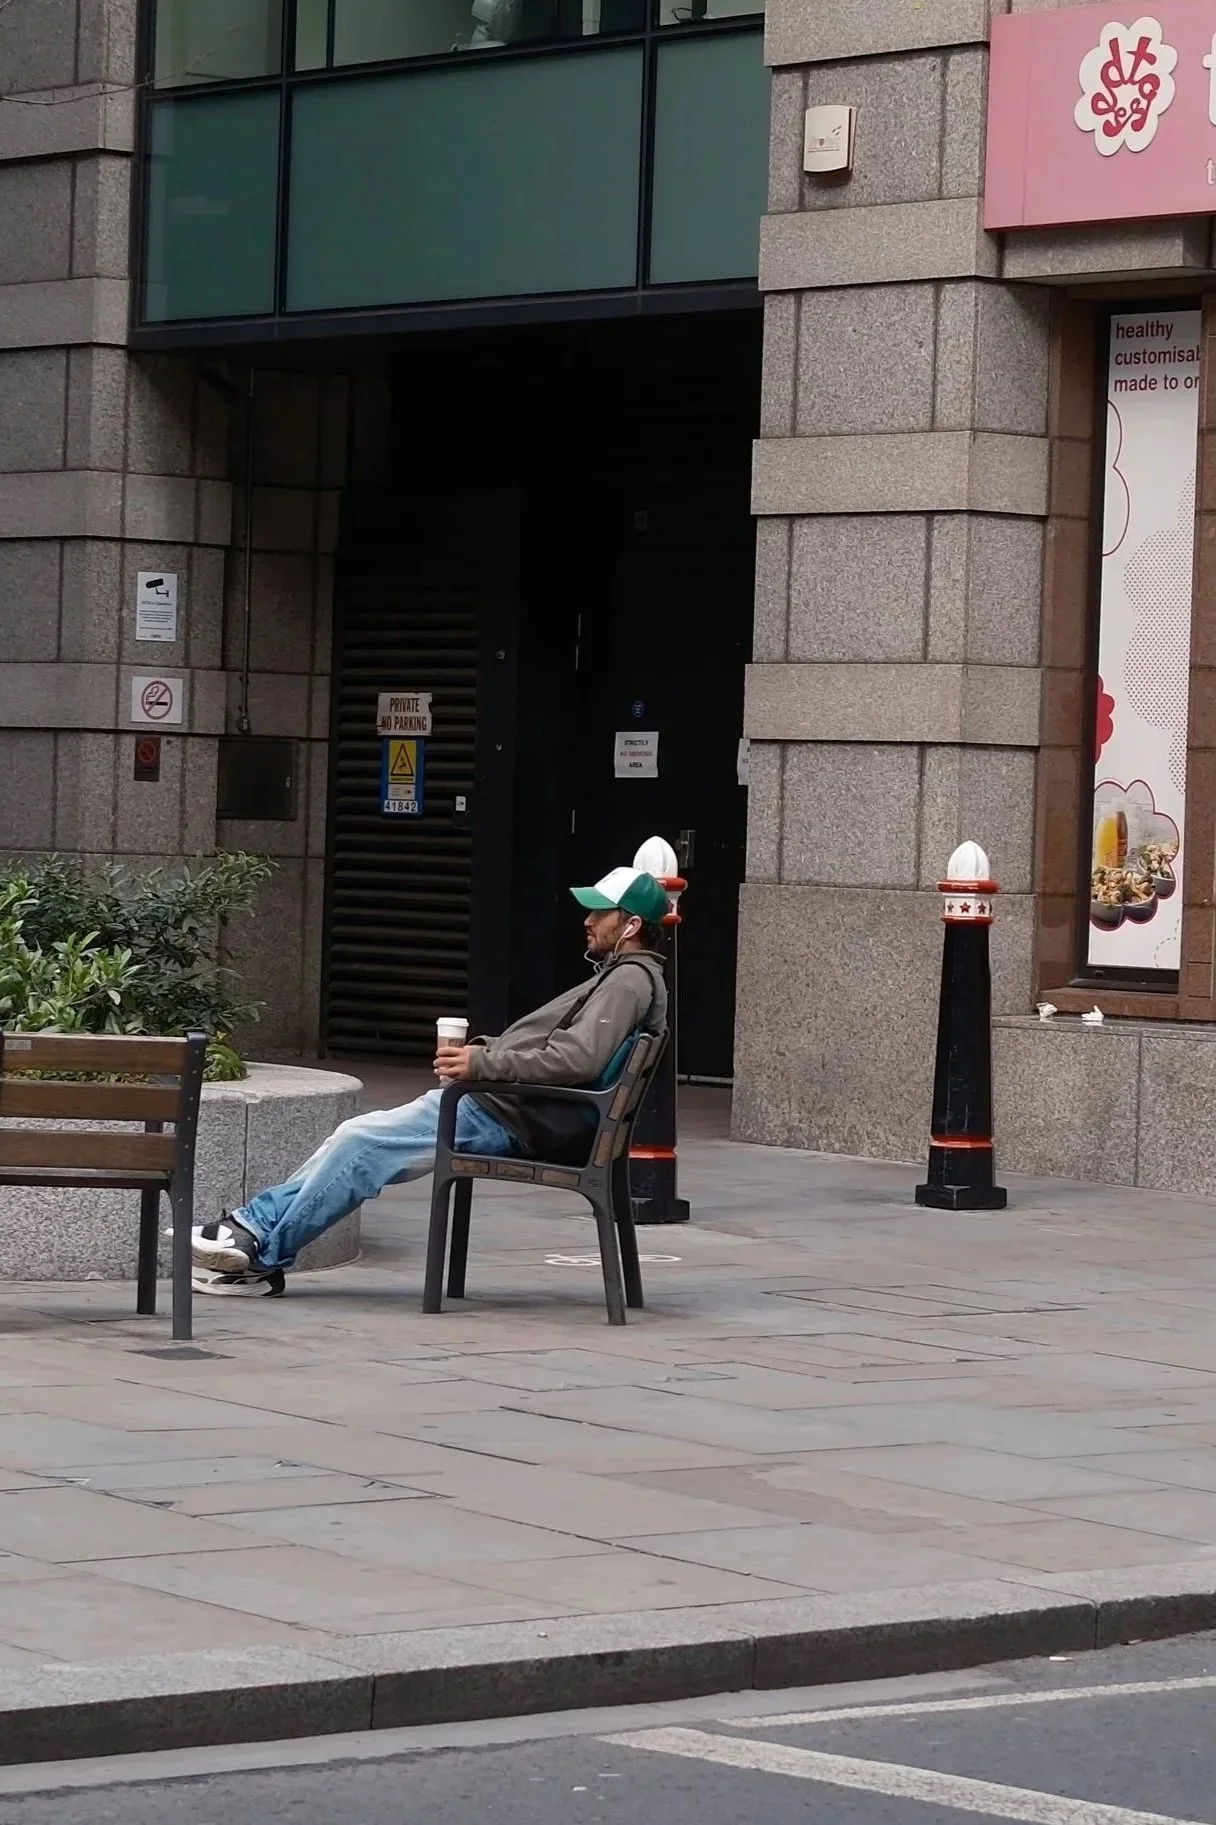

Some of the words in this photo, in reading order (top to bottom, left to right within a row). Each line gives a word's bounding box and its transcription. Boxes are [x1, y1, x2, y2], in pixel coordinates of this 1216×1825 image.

[1116, 320, 1173, 340] healthy
[1114, 374, 1157, 392] made
[1163, 374, 1178, 390] to
[389, 697, 420, 712] PRIVATE
[381, 716, 392, 730] NO
[394, 716, 427, 731] PARKING
[385, 801, 417, 812] 41842
